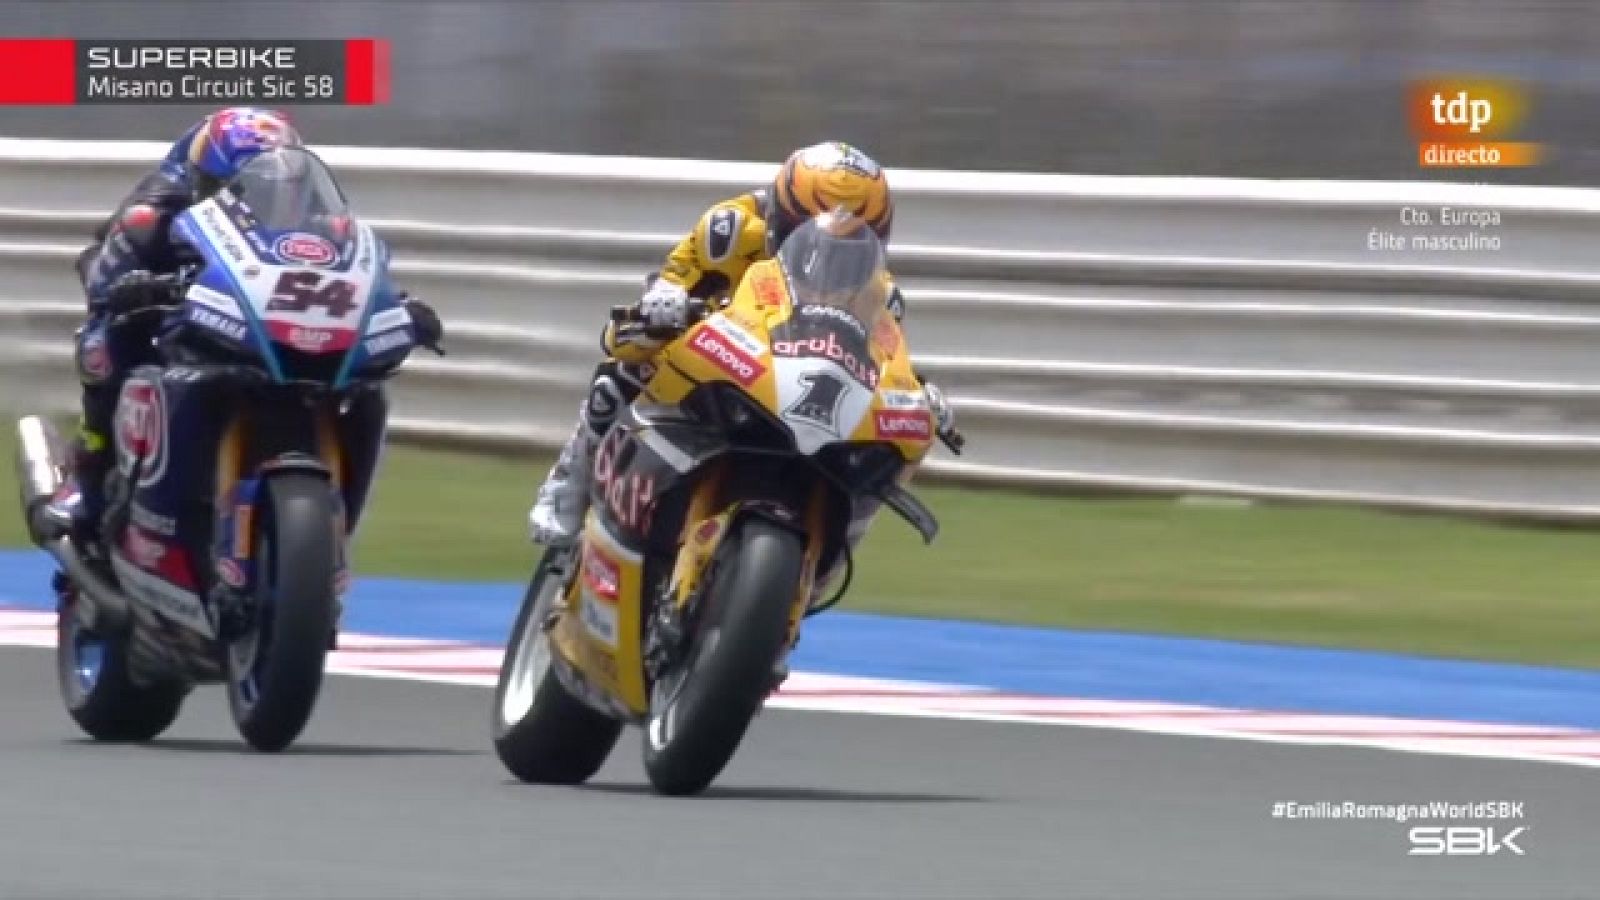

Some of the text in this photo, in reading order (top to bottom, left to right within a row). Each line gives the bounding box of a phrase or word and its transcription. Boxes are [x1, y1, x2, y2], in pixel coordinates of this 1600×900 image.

[264, 271, 361, 319] 54
[694, 331, 754, 378] Lenovo
[783, 373, 852, 438] 1
